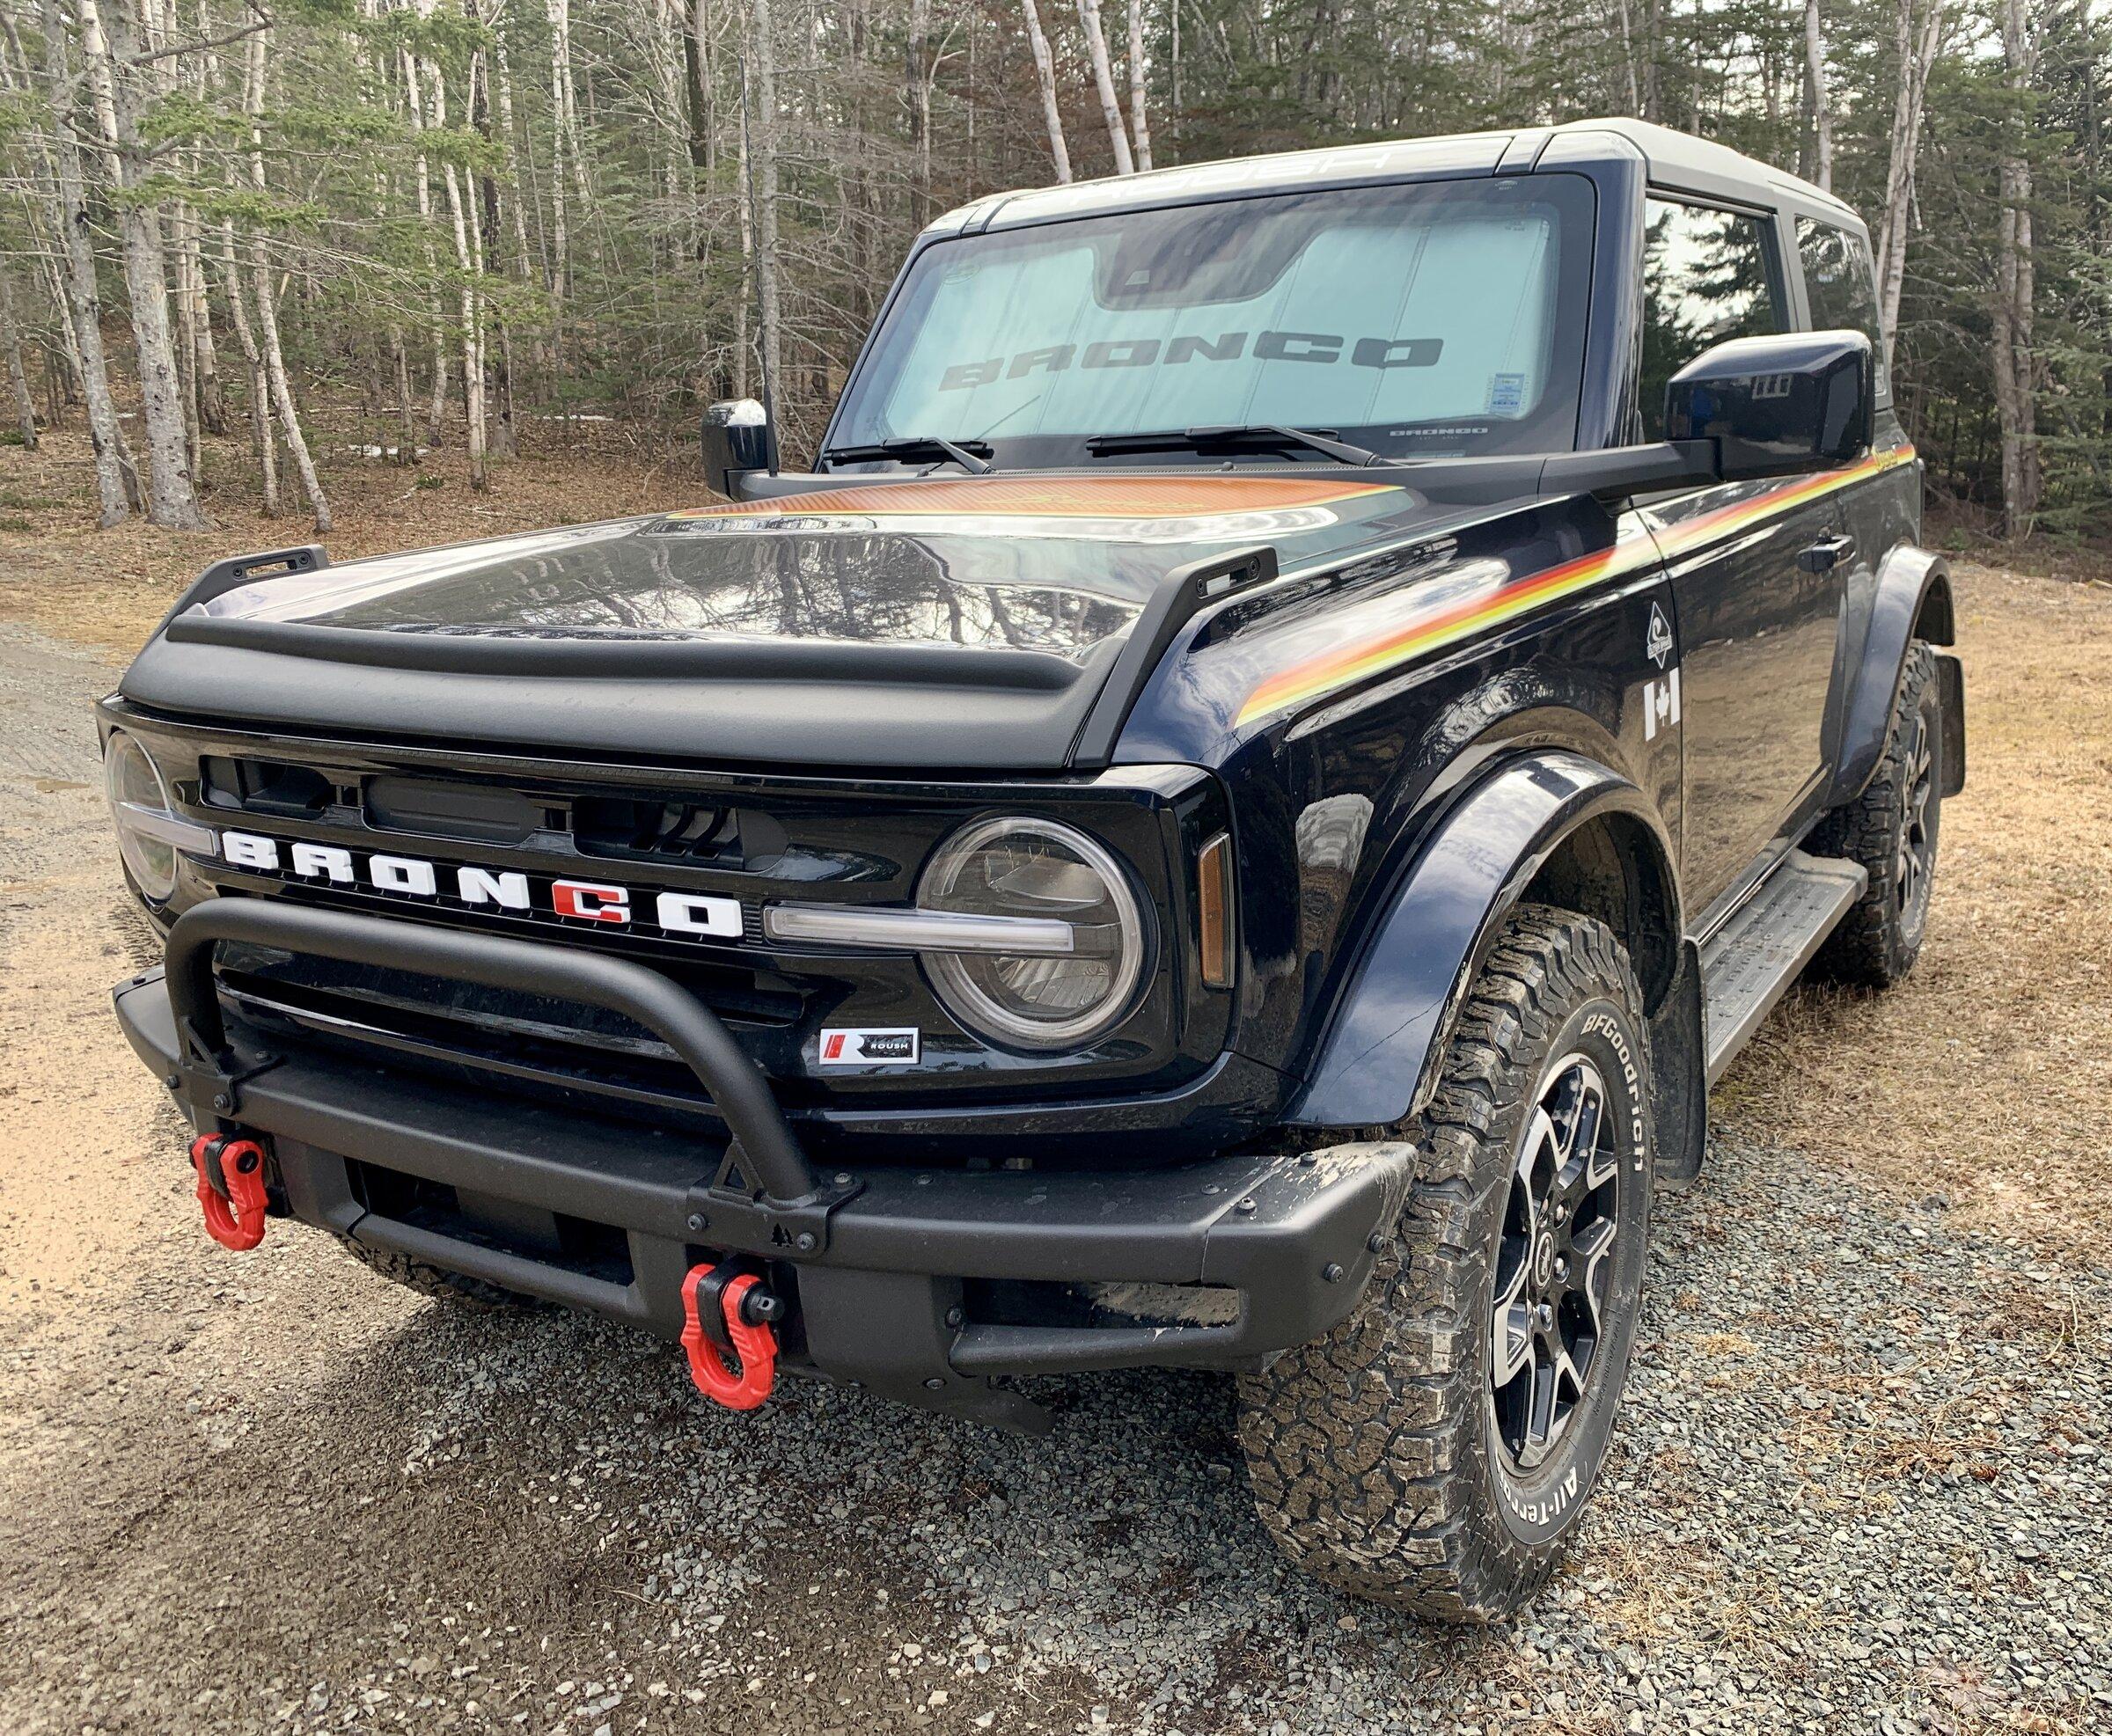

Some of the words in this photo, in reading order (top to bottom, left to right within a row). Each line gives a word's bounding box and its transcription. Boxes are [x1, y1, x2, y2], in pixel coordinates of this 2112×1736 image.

[938, 331, 1444, 392] BRONCO
[223, 831, 744, 937] BRONCO
[1580, 1013, 1645, 1172] BFGoodrich
